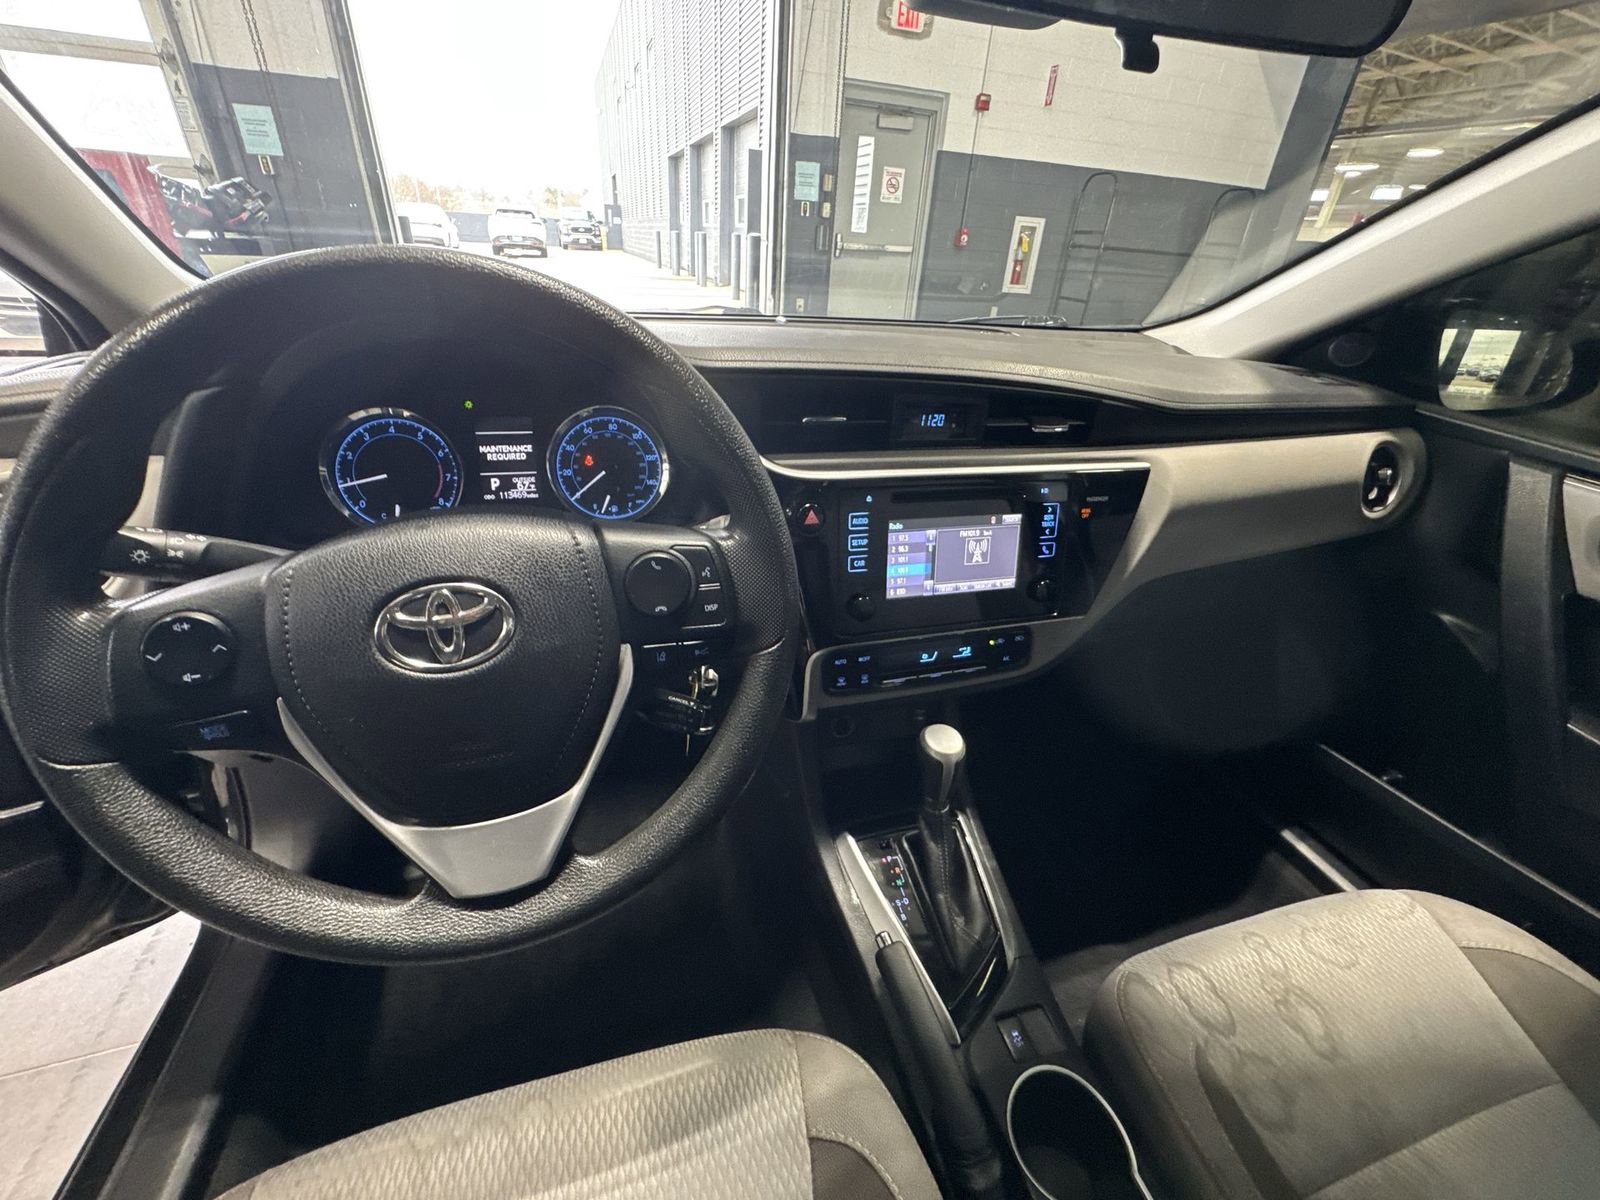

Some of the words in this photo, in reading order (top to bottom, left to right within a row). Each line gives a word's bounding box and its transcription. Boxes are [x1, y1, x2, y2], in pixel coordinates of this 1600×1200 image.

[363, 433, 370, 441] 3
[417, 432, 423, 440] 5
[479, 444, 533, 453] MAINTENANCE
[487, 452, 527, 461] REQUIRED
[445, 473, 451, 481] 7
[490, 477, 500, 491] P
[438, 498, 444, 506] 8
[852, 517, 869, 525] AUDIO
[888, 522, 903, 530] Radio
[851, 538, 869, 546] SETUP
[853, 559, 866, 567] CAR
[704, 604, 718, 612] DISP
